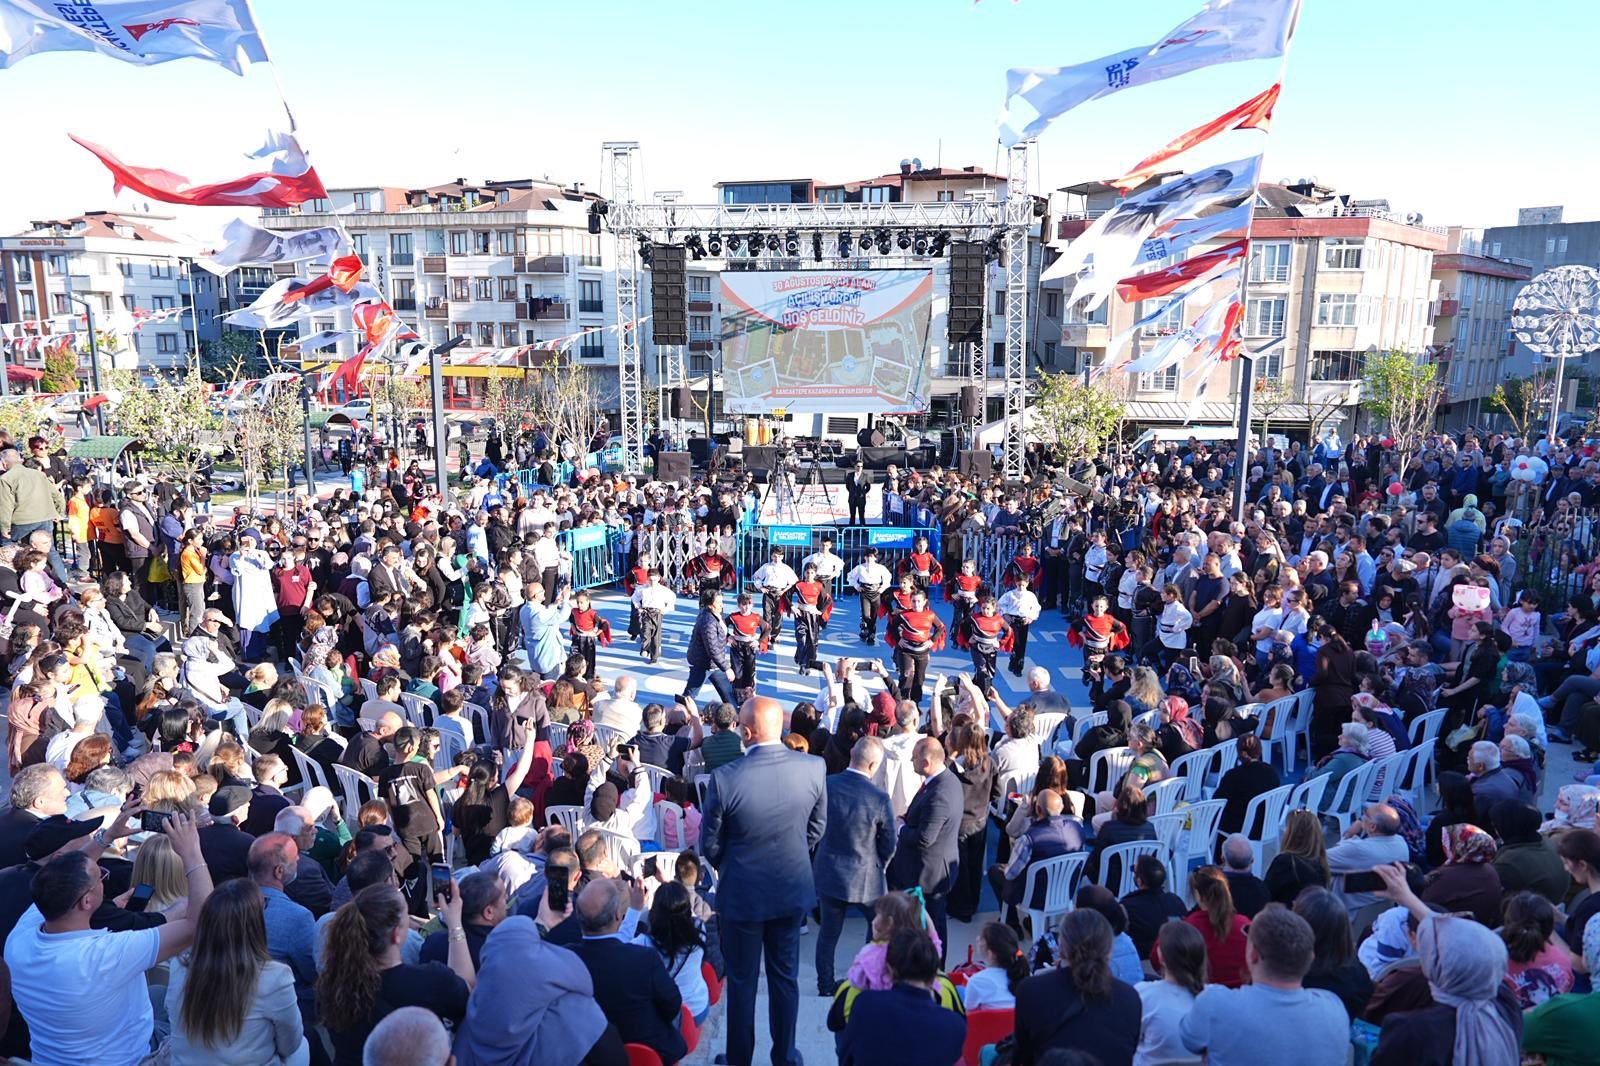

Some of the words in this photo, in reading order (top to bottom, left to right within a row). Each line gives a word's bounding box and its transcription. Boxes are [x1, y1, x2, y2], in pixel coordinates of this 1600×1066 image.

[785, 276, 822, 290] AĞUSTOS
[783, 310, 808, 328] HOŞ
[809, 307, 865, 326] GELDİNİZ
